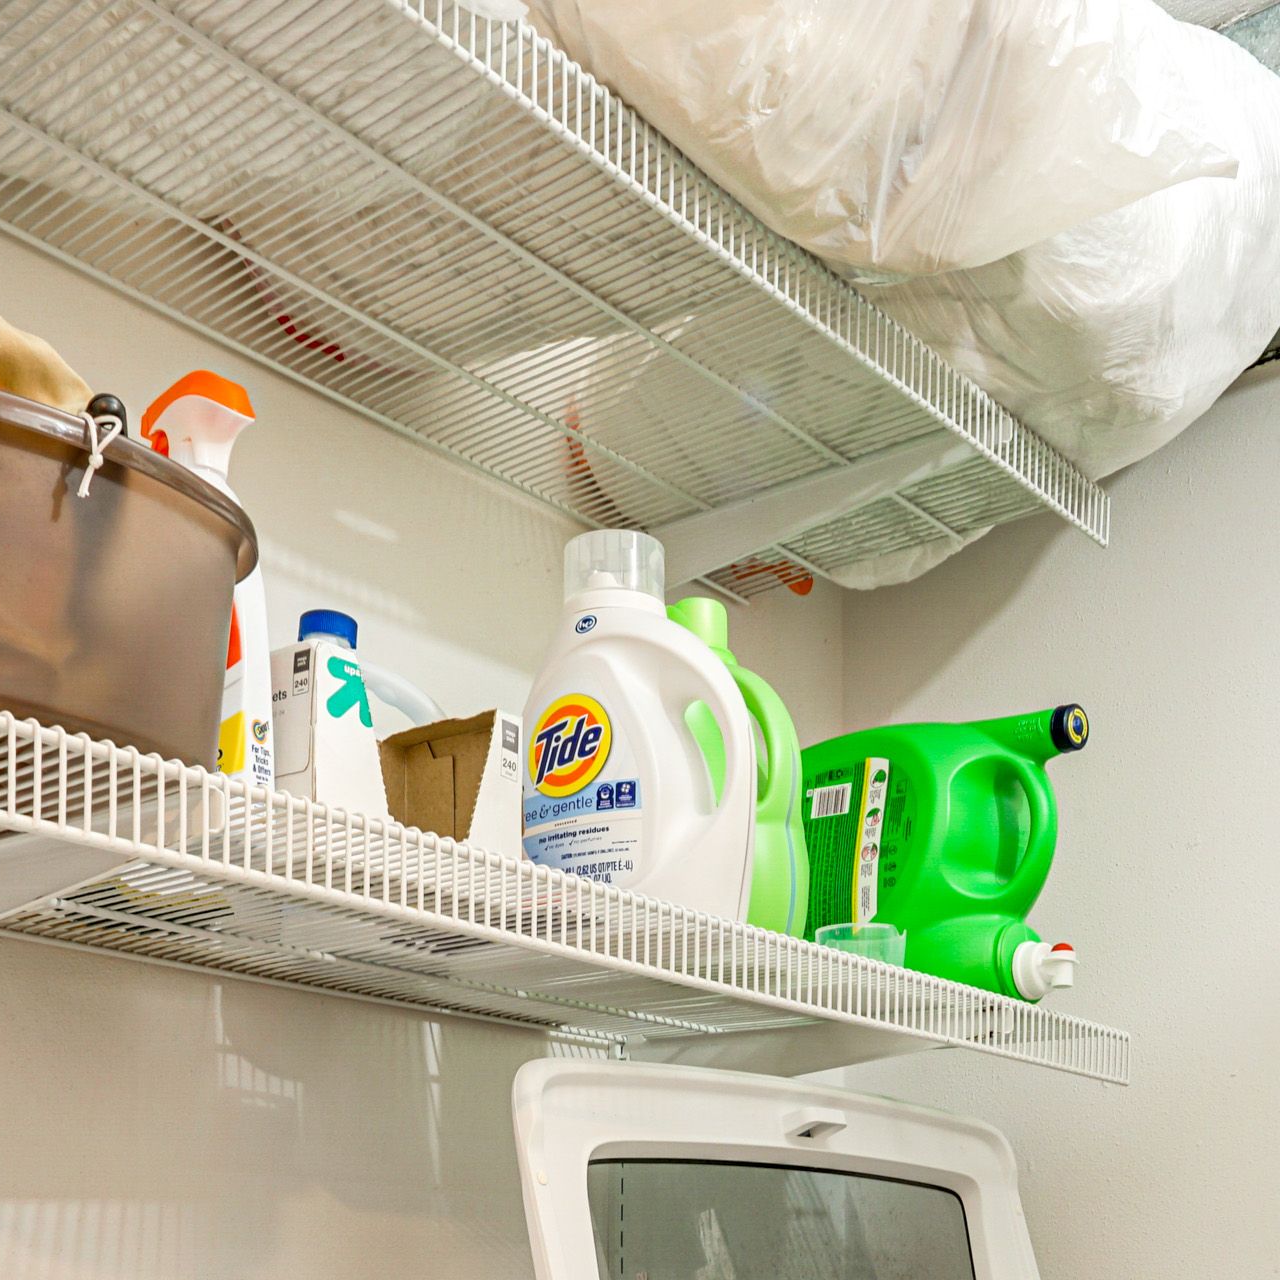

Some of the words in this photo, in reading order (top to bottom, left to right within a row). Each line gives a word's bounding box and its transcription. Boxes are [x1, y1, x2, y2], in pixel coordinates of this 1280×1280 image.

[294, 678, 308, 688] 240
[272, 690, 287, 702] ets
[535, 716, 603, 785] Tide
[502, 758, 516, 772] 240
[539, 805, 549, 819] &
[552, 797, 593, 816] gentle
[547, 831, 577, 843] irritating
[578, 826, 610, 837] residues
[590, 863, 597, 874] US
